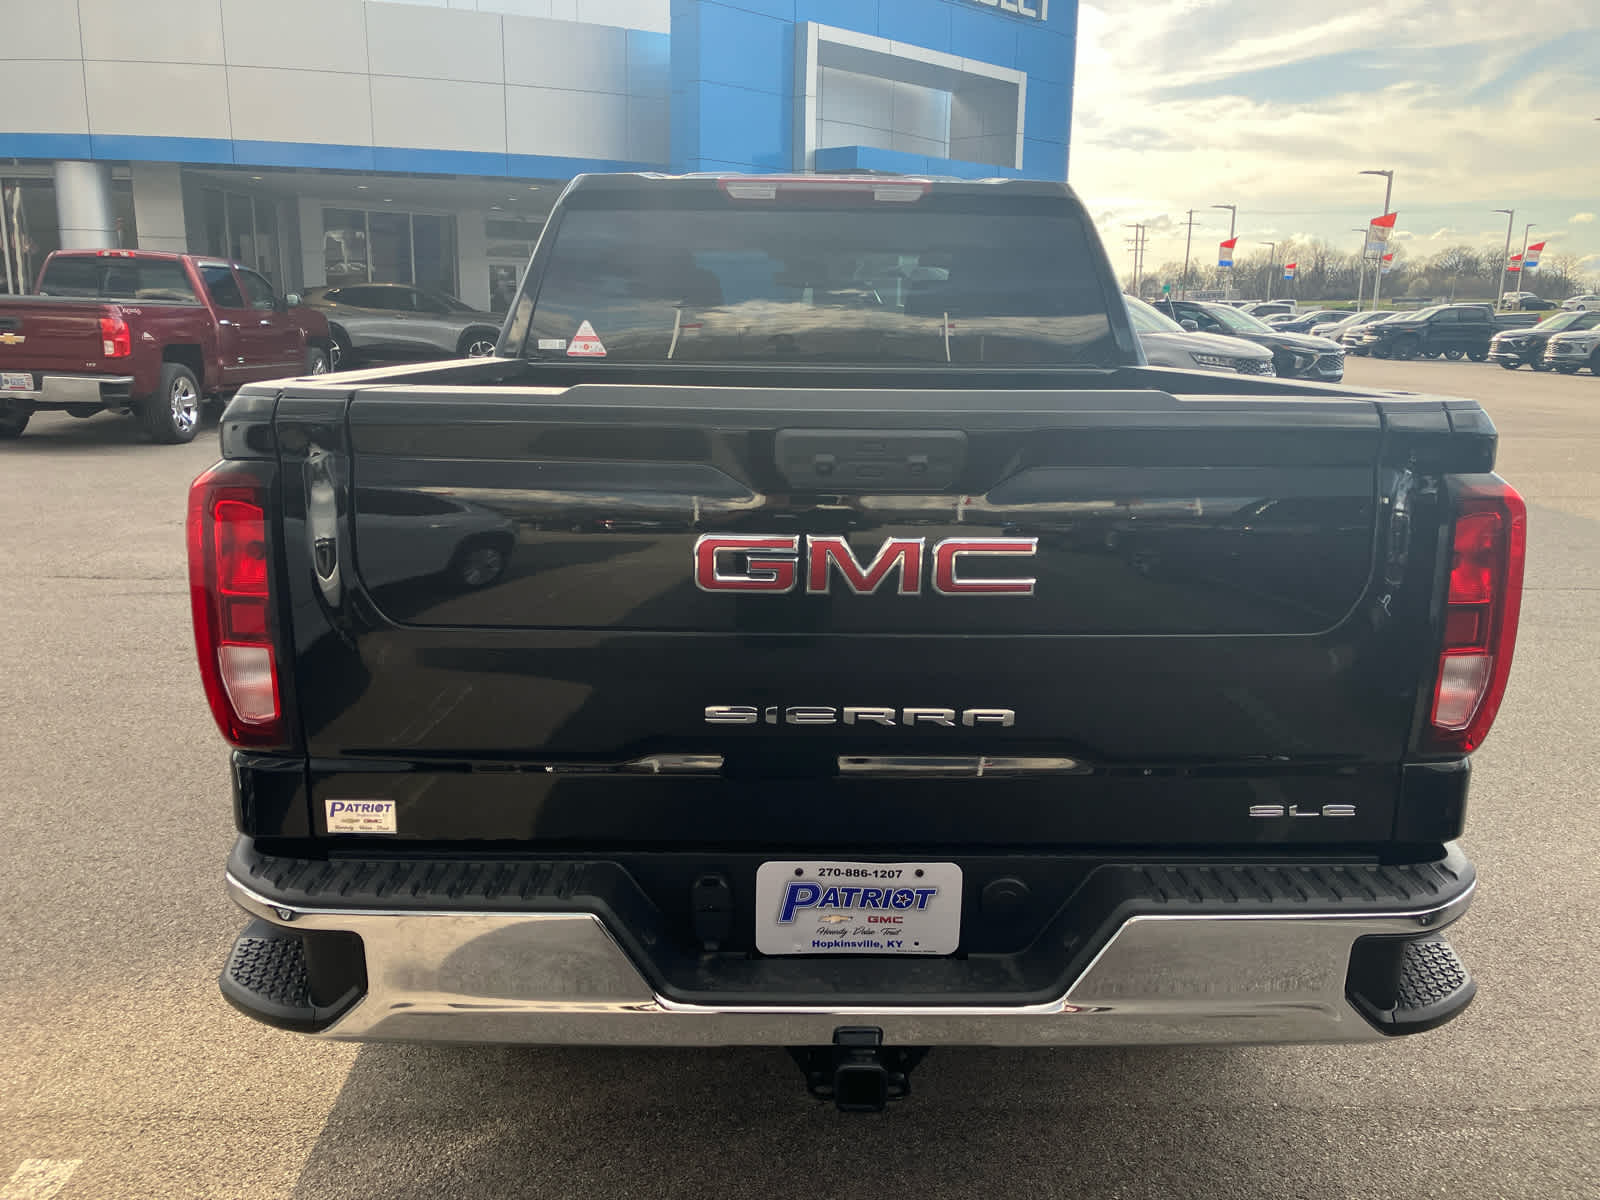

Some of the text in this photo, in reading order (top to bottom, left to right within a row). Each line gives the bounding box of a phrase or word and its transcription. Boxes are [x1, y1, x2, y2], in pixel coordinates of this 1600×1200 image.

[693, 533, 1039, 596] GMC
[704, 705, 1016, 728] SIERRA
[330, 802, 392, 817] PATRIOT
[1249, 804, 1357, 817] SLE
[818, 867, 903, 879] 270-886-1207
[778, 881, 937, 924] PATRIOT
[867, 915, 904, 924] GMC
[815, 926, 849, 938] Honesty
[880, 927, 902, 936] Trust
[811, 939, 904, 949] Hopkinsville, KY
